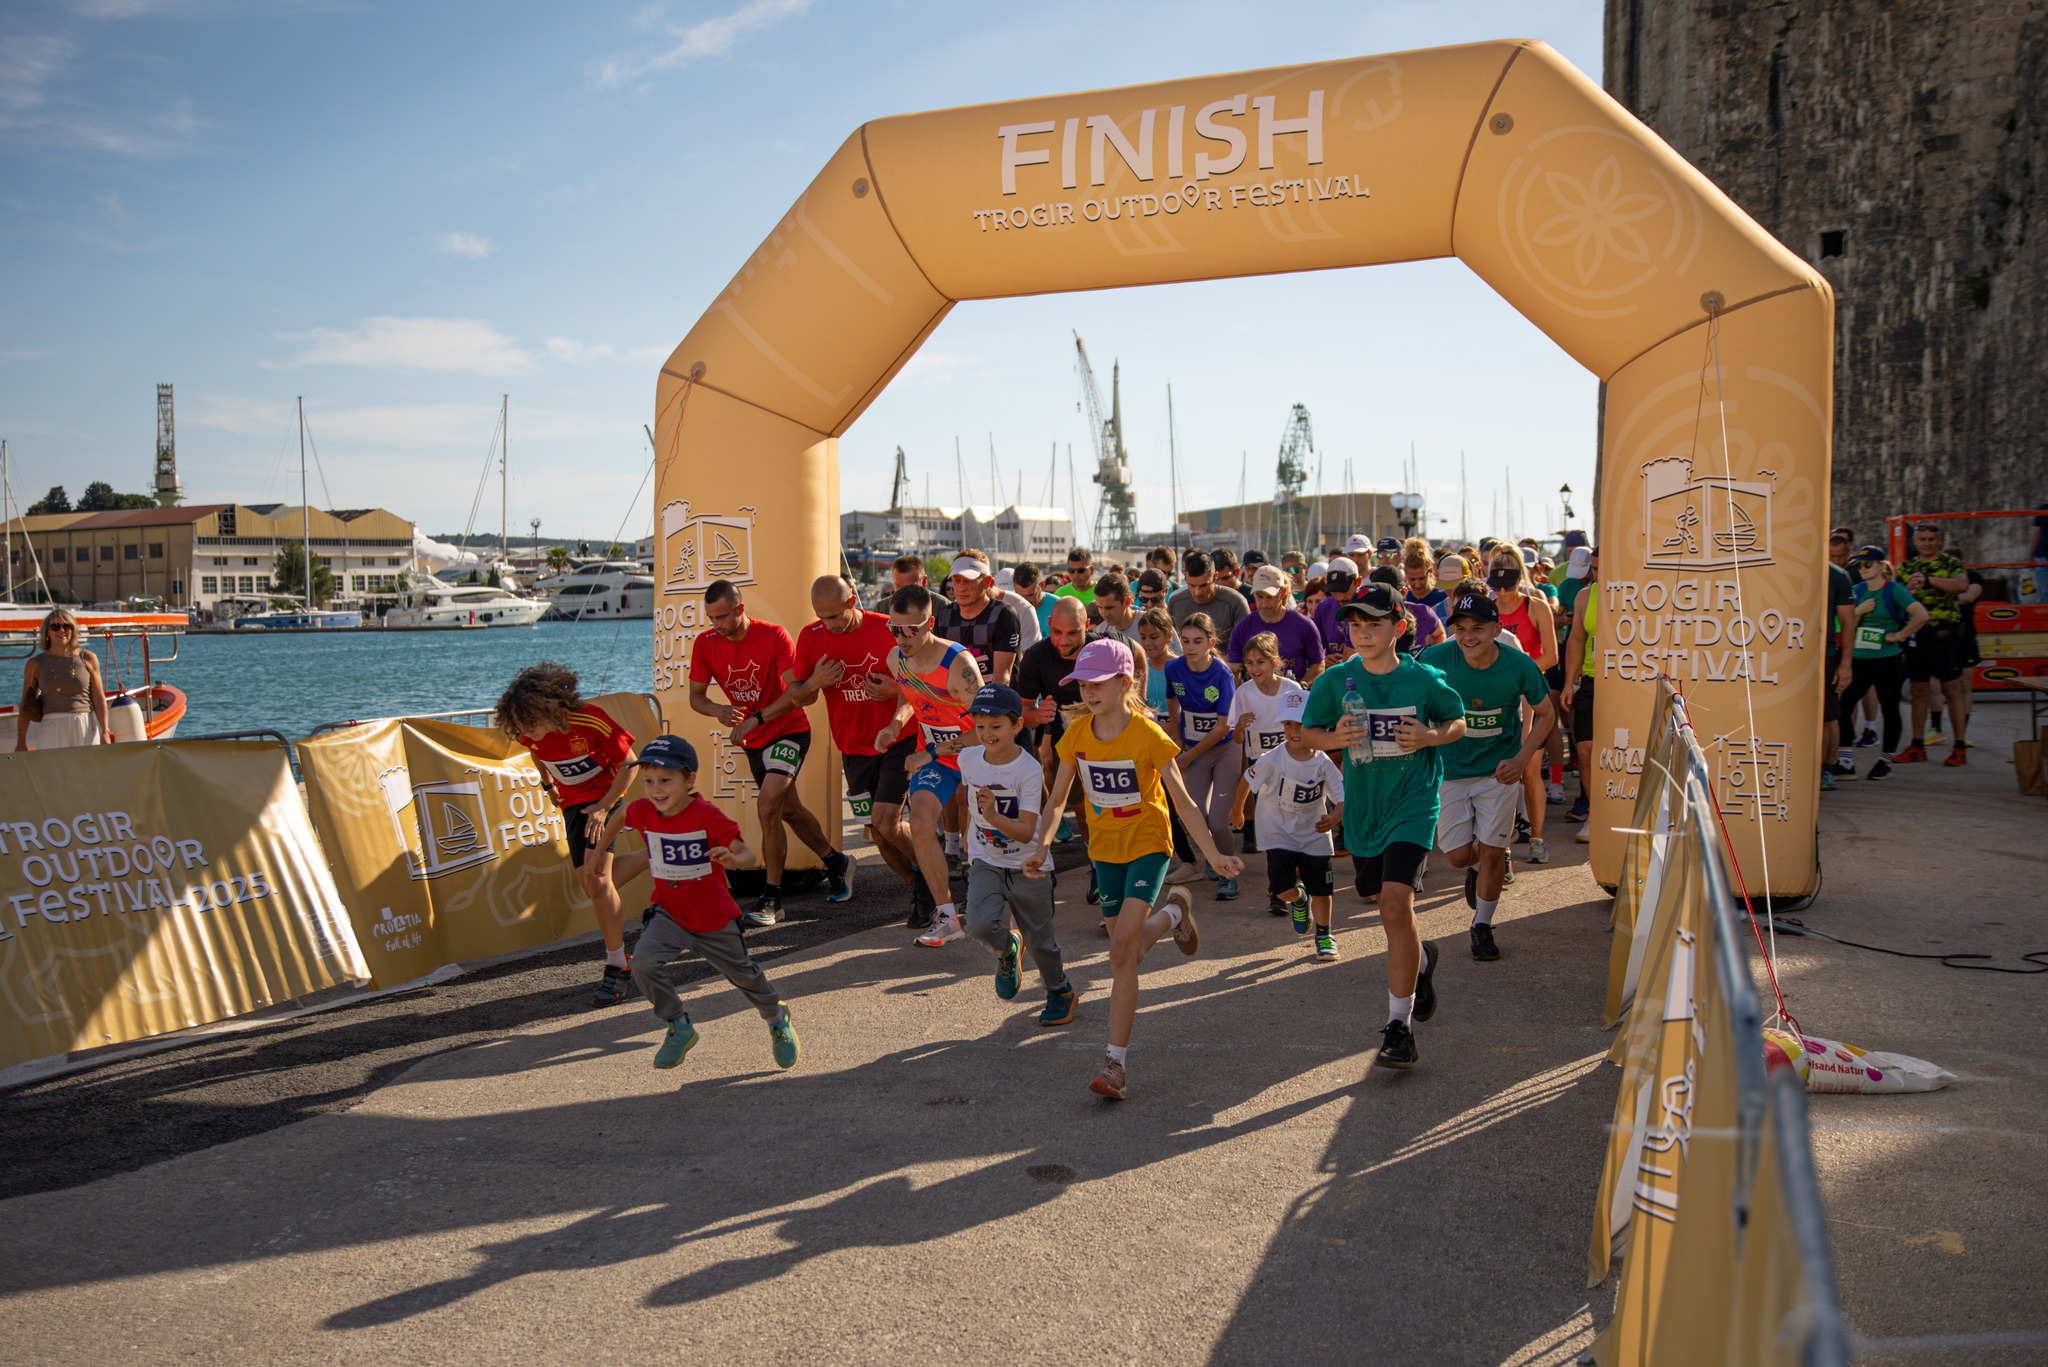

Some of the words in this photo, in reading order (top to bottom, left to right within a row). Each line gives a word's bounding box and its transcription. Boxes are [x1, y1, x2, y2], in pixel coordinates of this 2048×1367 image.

[998, 89, 1326, 196] FINISH
[973, 202, 1076, 233] TROGIR
[1606, 578, 1741, 612] TROGIR
[1374, 720, 1406, 737] 35
[1467, 716, 1497, 727] 158
[774, 746, 796, 760] 149
[559, 761, 590, 776] 311
[1093, 771, 1131, 789] 316
[1296, 785, 1321, 801] 319
[853, 801, 870, 813] 50
[0, 811, 137, 856] TROGIR
[664, 843, 703, 861] 318
[1837, 1063, 1865, 1076] Natur
